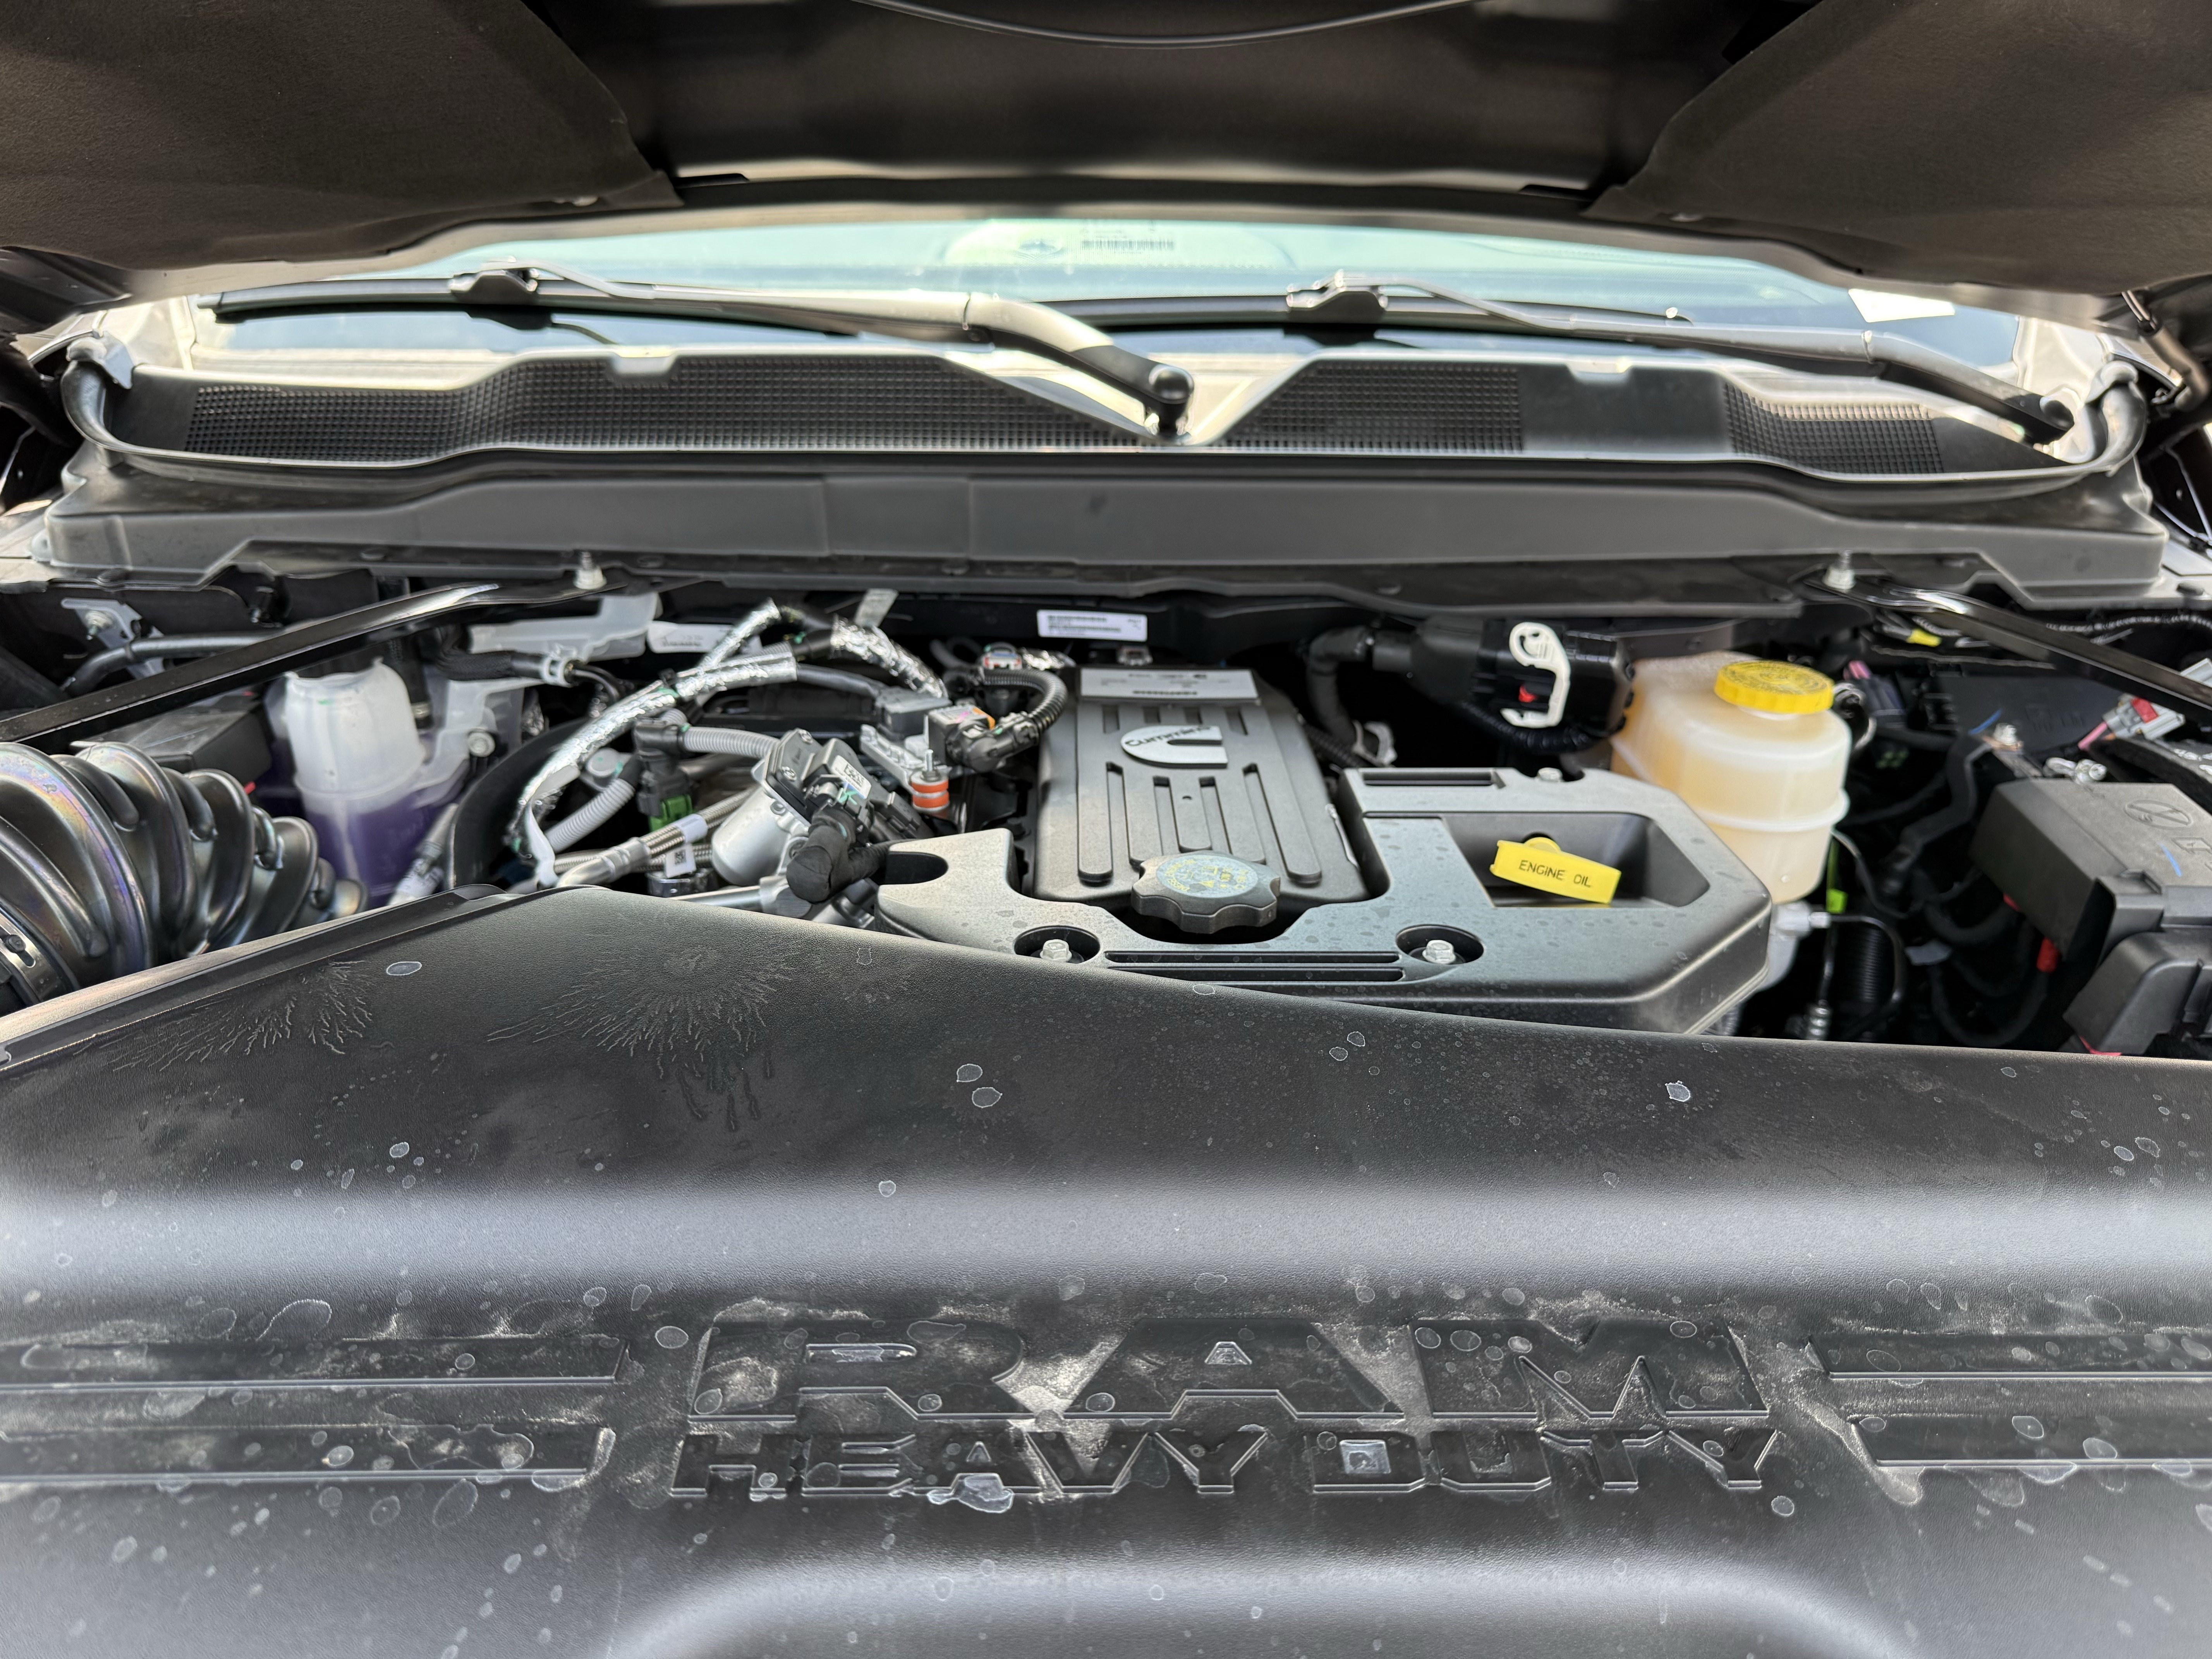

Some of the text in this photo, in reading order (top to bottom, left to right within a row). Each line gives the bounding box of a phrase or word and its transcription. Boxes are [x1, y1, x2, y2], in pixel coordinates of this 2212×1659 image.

[1125, 725, 1211, 747] Cummins
[1518, 860, 1591, 888] ENGINE OIL
[688, 1318, 1767, 1420] RAM
[671, 1429, 1777, 1497] HEAVY DUTY
